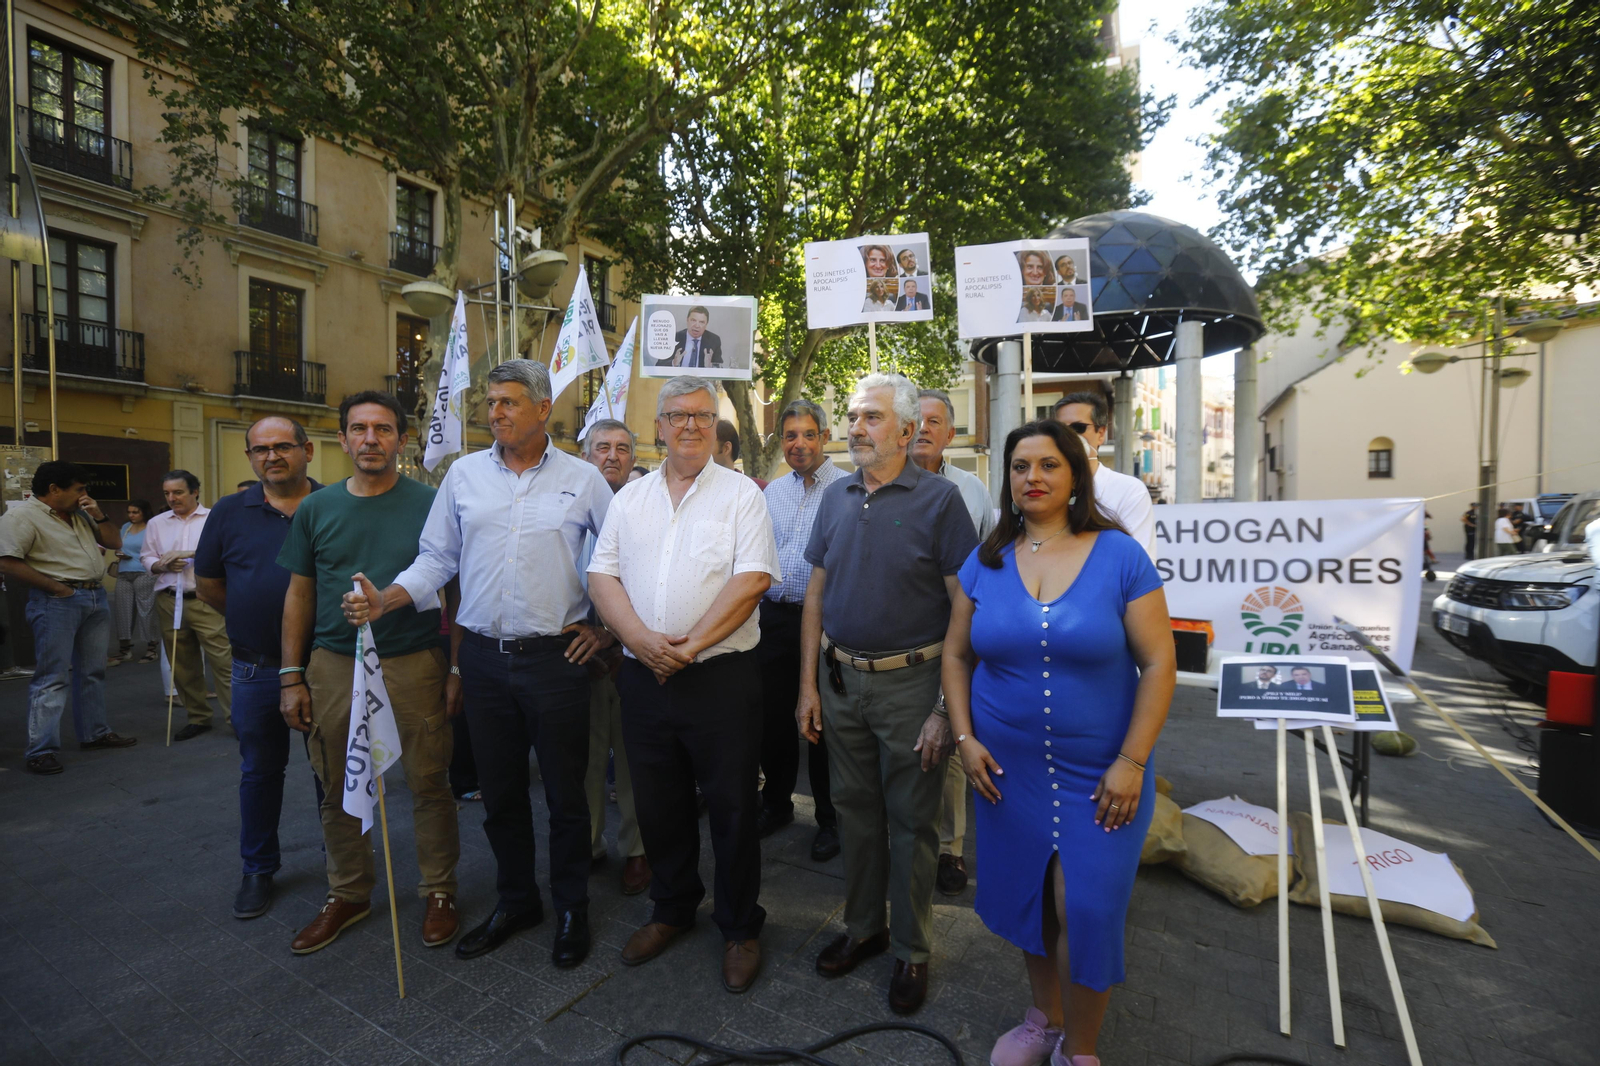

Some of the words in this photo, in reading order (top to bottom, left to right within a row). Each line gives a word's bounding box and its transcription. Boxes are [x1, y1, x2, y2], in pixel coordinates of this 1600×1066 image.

[813, 275, 848, 284] APOCALIPSIS
[814, 284, 832, 292] RURAL
[964, 282, 1002, 291] APOCALIPSIS
[964, 291, 985, 299] RURAL
[1156, 517, 1324, 544] AHOGAN
[1156, 557, 1402, 585] SUMIDORES
[1308, 643, 1316, 652] y
[1204, 808, 1279, 836] NARANJAS
